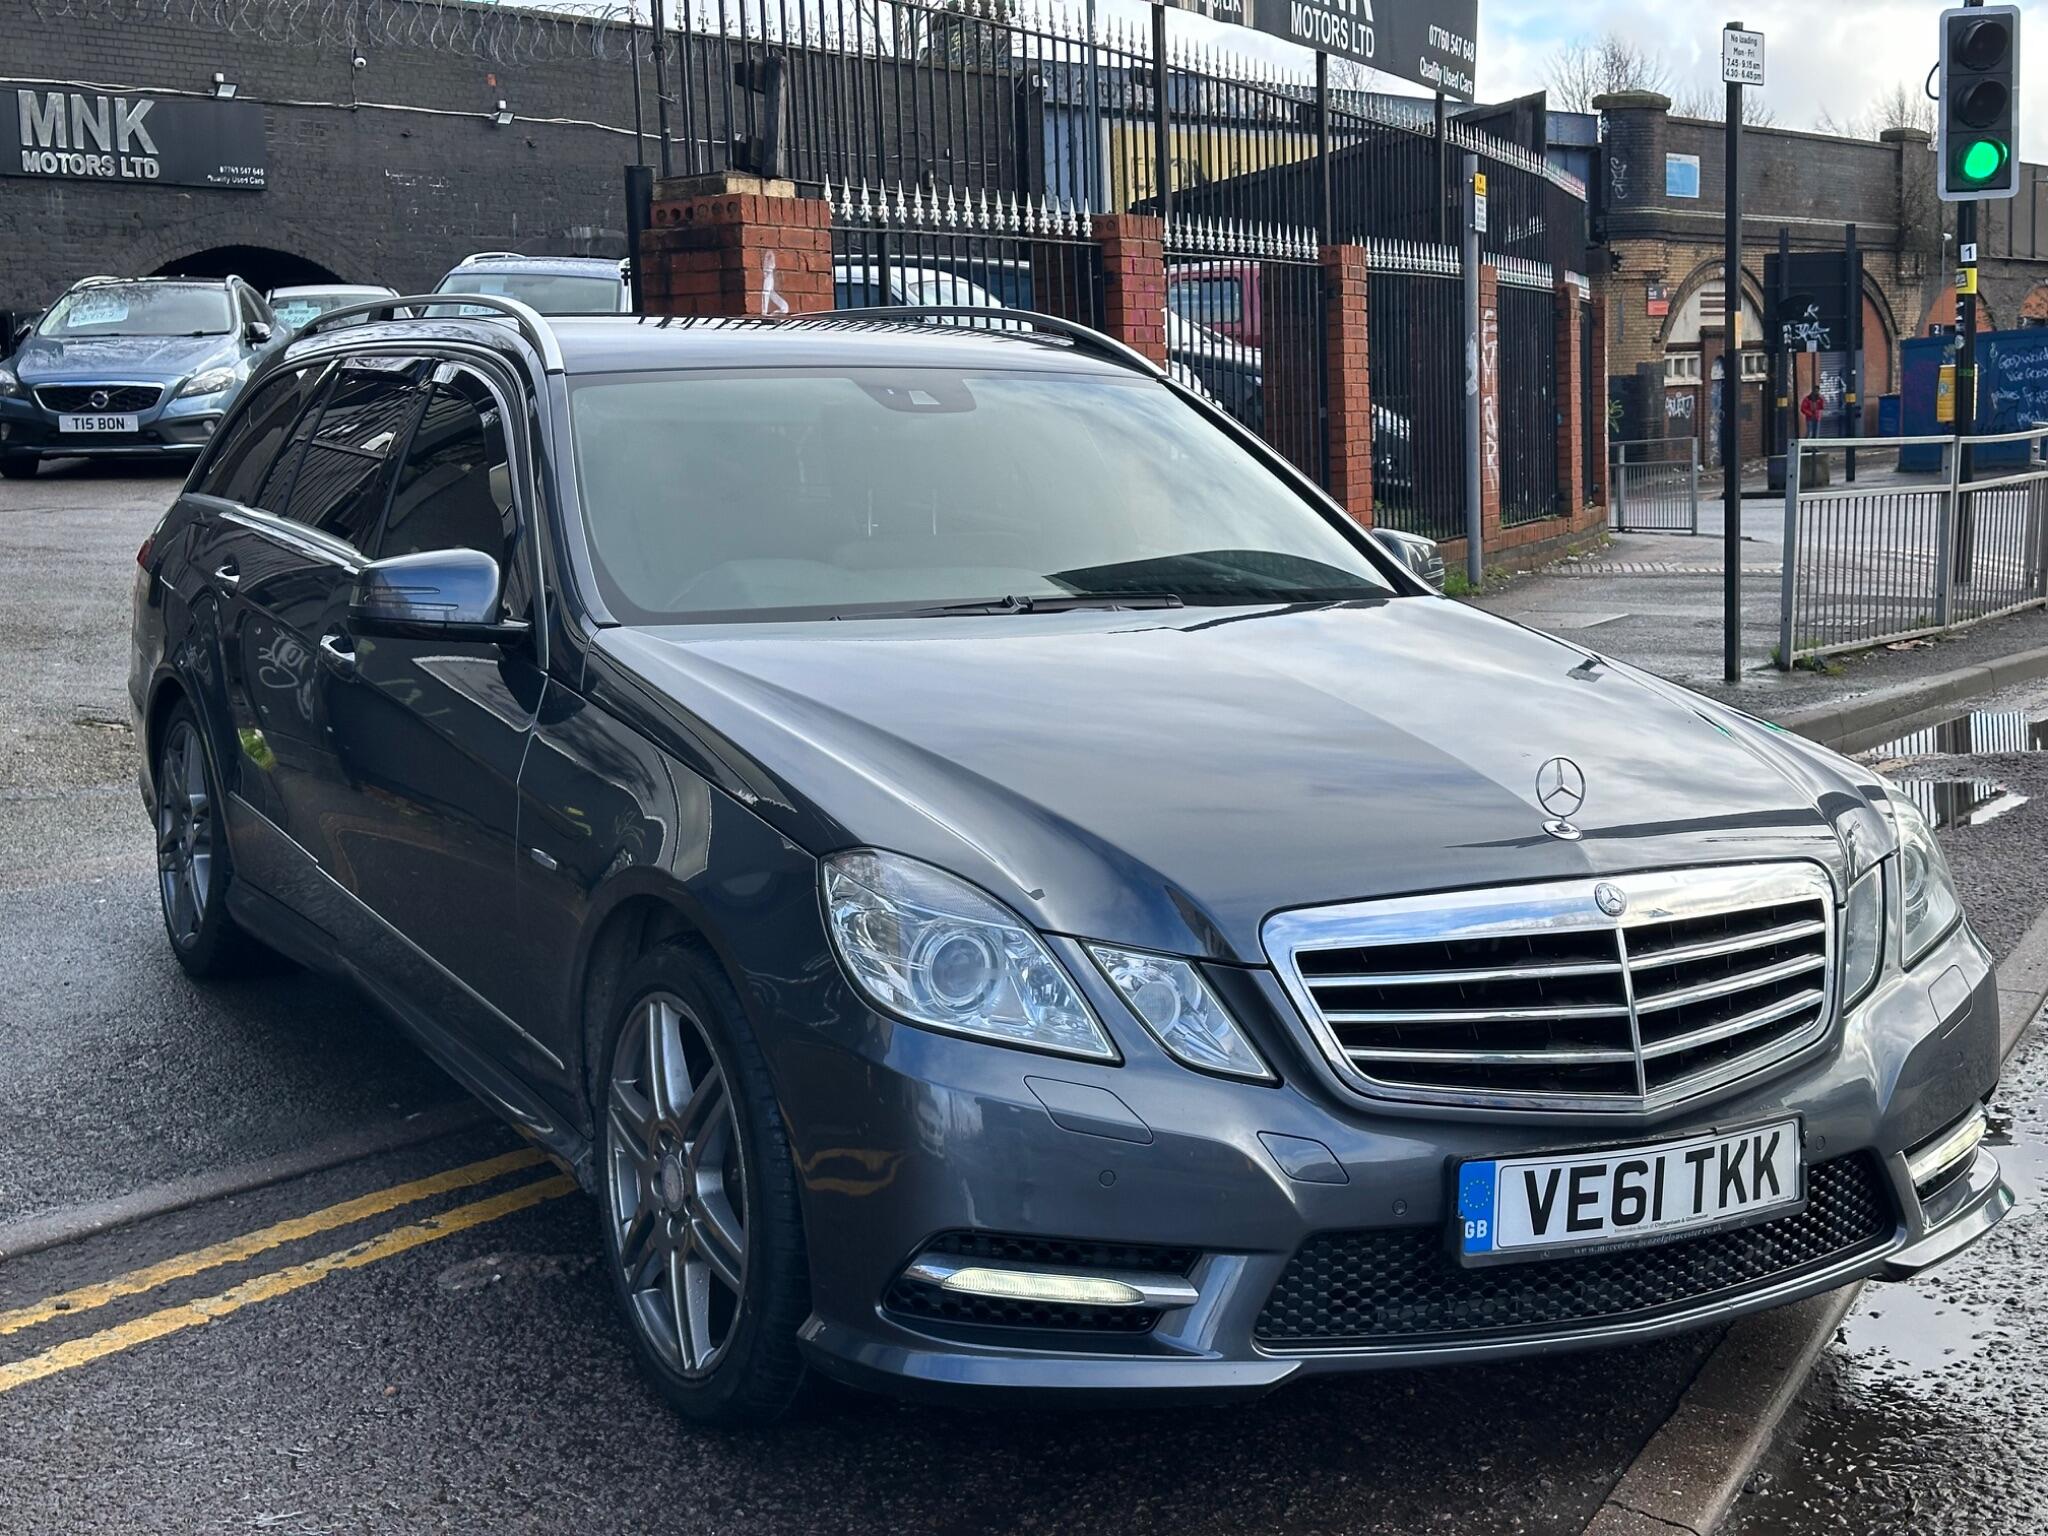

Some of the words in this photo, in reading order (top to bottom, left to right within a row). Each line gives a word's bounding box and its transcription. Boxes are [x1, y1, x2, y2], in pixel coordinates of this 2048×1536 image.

[1291, 0, 1349, 50] MOTORS
[1351, 21, 1375, 58] LTD
[1450, 33, 1462, 56] 547
[1730, 33, 1738, 43] No
[1739, 35, 1758, 47] loading
[1733, 47, 1745, 56] Mon
[1420, 56, 1442, 87] Quality
[1443, 65, 1459, 89] Used
[1460, 72, 1473, 95] Cars
[1753, 73, 1761, 81] pm
[18, 89, 159, 155] MNK
[21, 150, 116, 177] MOTORS
[120, 156, 160, 179] LTD
[1965, 246, 1972, 259] 1
[97, 417, 125, 430] BON
[1523, 1156, 1665, 1236] VE61
[1685, 1131, 1780, 1214] TKK
[1464, 1219, 1487, 1239] GB
